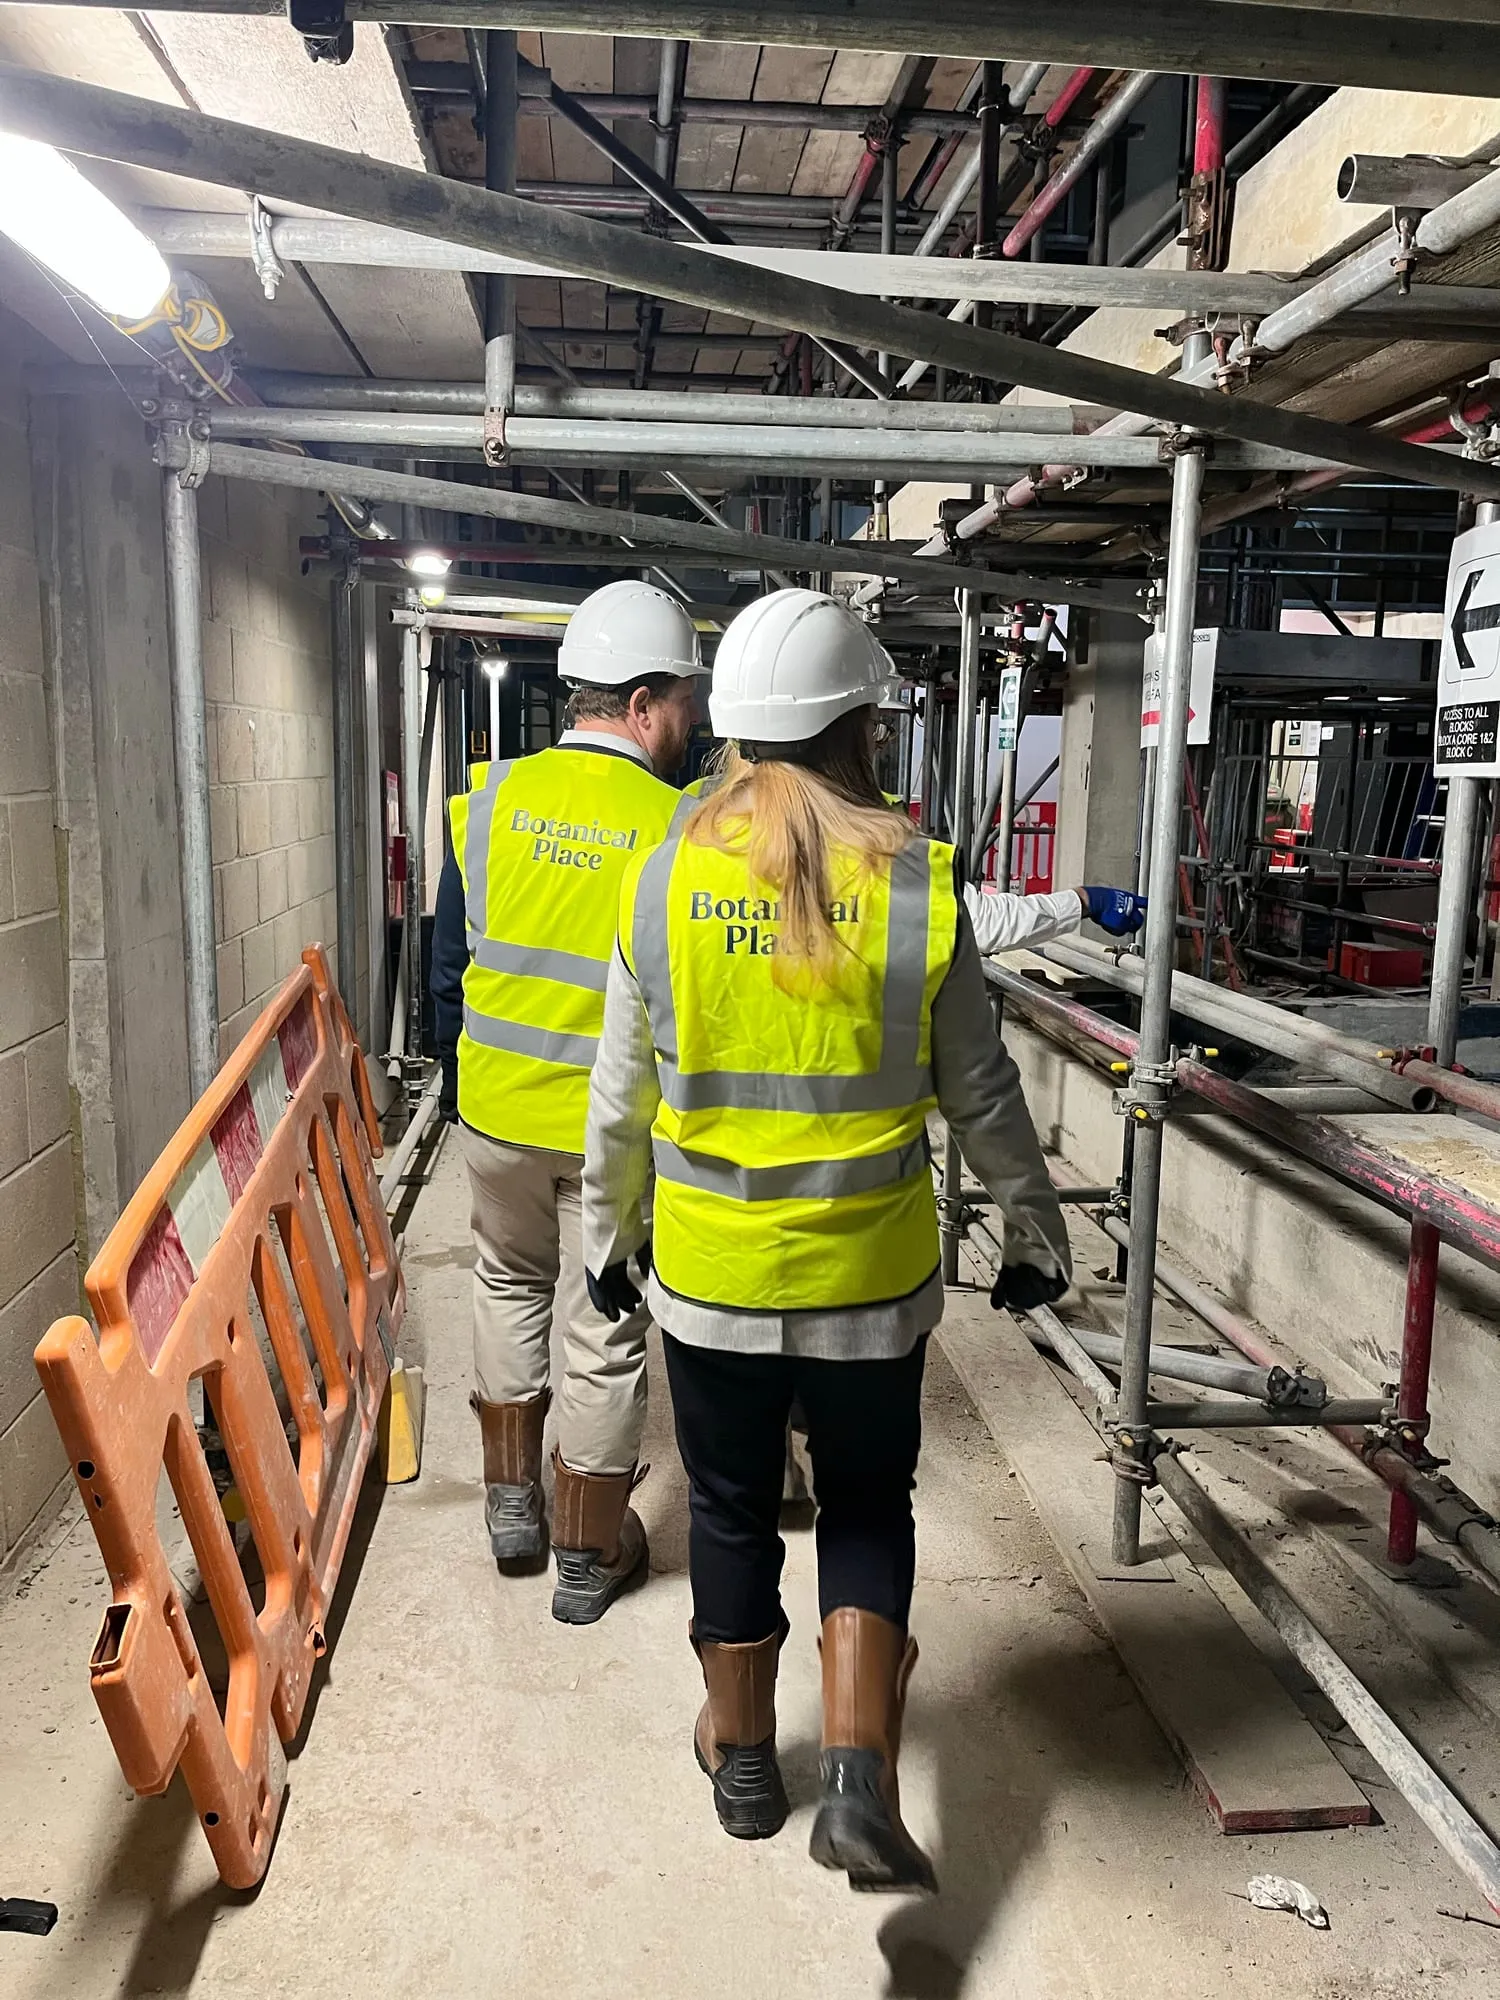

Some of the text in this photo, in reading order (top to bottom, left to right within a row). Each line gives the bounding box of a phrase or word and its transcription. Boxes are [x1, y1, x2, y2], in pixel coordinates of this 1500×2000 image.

[1464, 707, 1475, 719] TO
[1475, 706, 1489, 718] ALL
[1449, 720, 1474, 733] BLOCKS
[1457, 732, 1478, 745] CORE
[1480, 732, 1494, 744] 1&2
[1446, 746, 1473, 758] BLOCK C
[510, 809, 638, 851] Botanical
[532, 838, 603, 870] Place
[690, 892, 860, 923] Botaal
